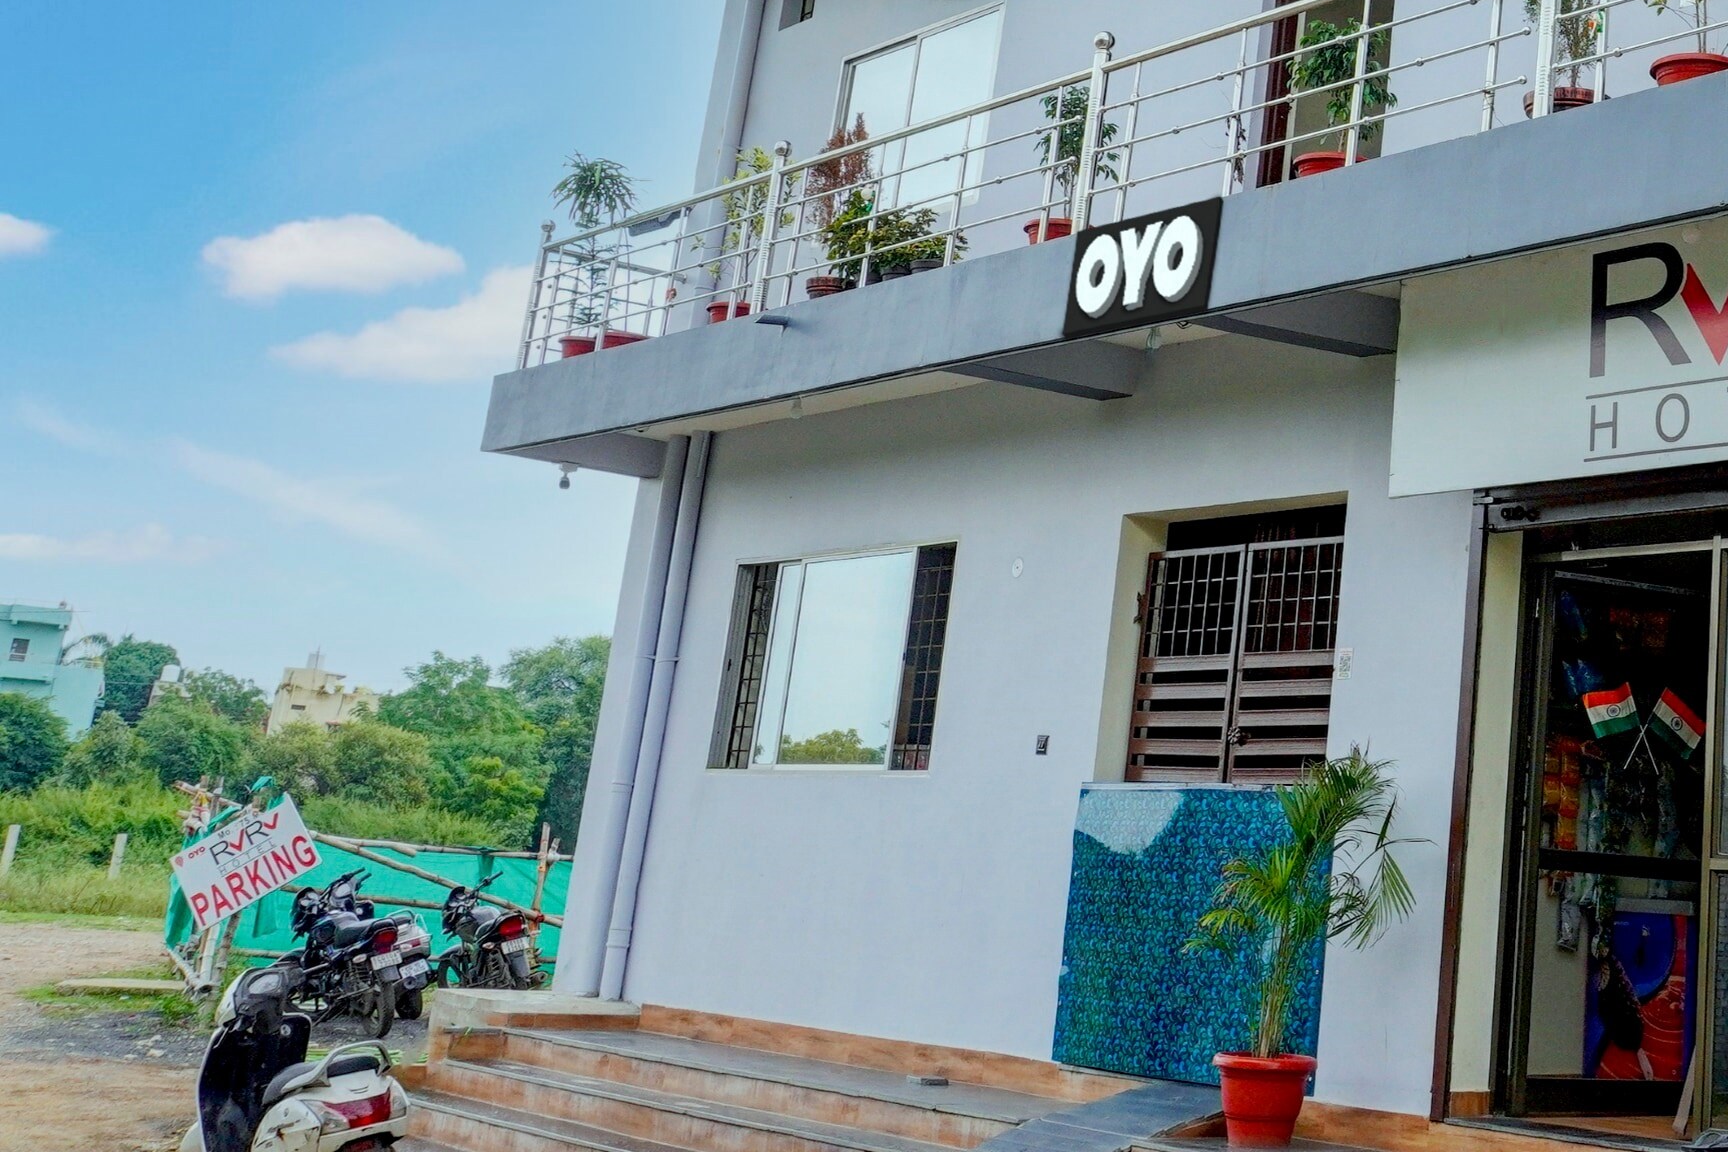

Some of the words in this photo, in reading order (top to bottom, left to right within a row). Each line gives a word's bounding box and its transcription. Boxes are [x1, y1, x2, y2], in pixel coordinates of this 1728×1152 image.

[1075, 214, 1202, 318] OYO
[188, 846, 206, 860] OYO
[190, 834, 318, 927] PARKING
[216, 841, 278, 875] HOTEL
